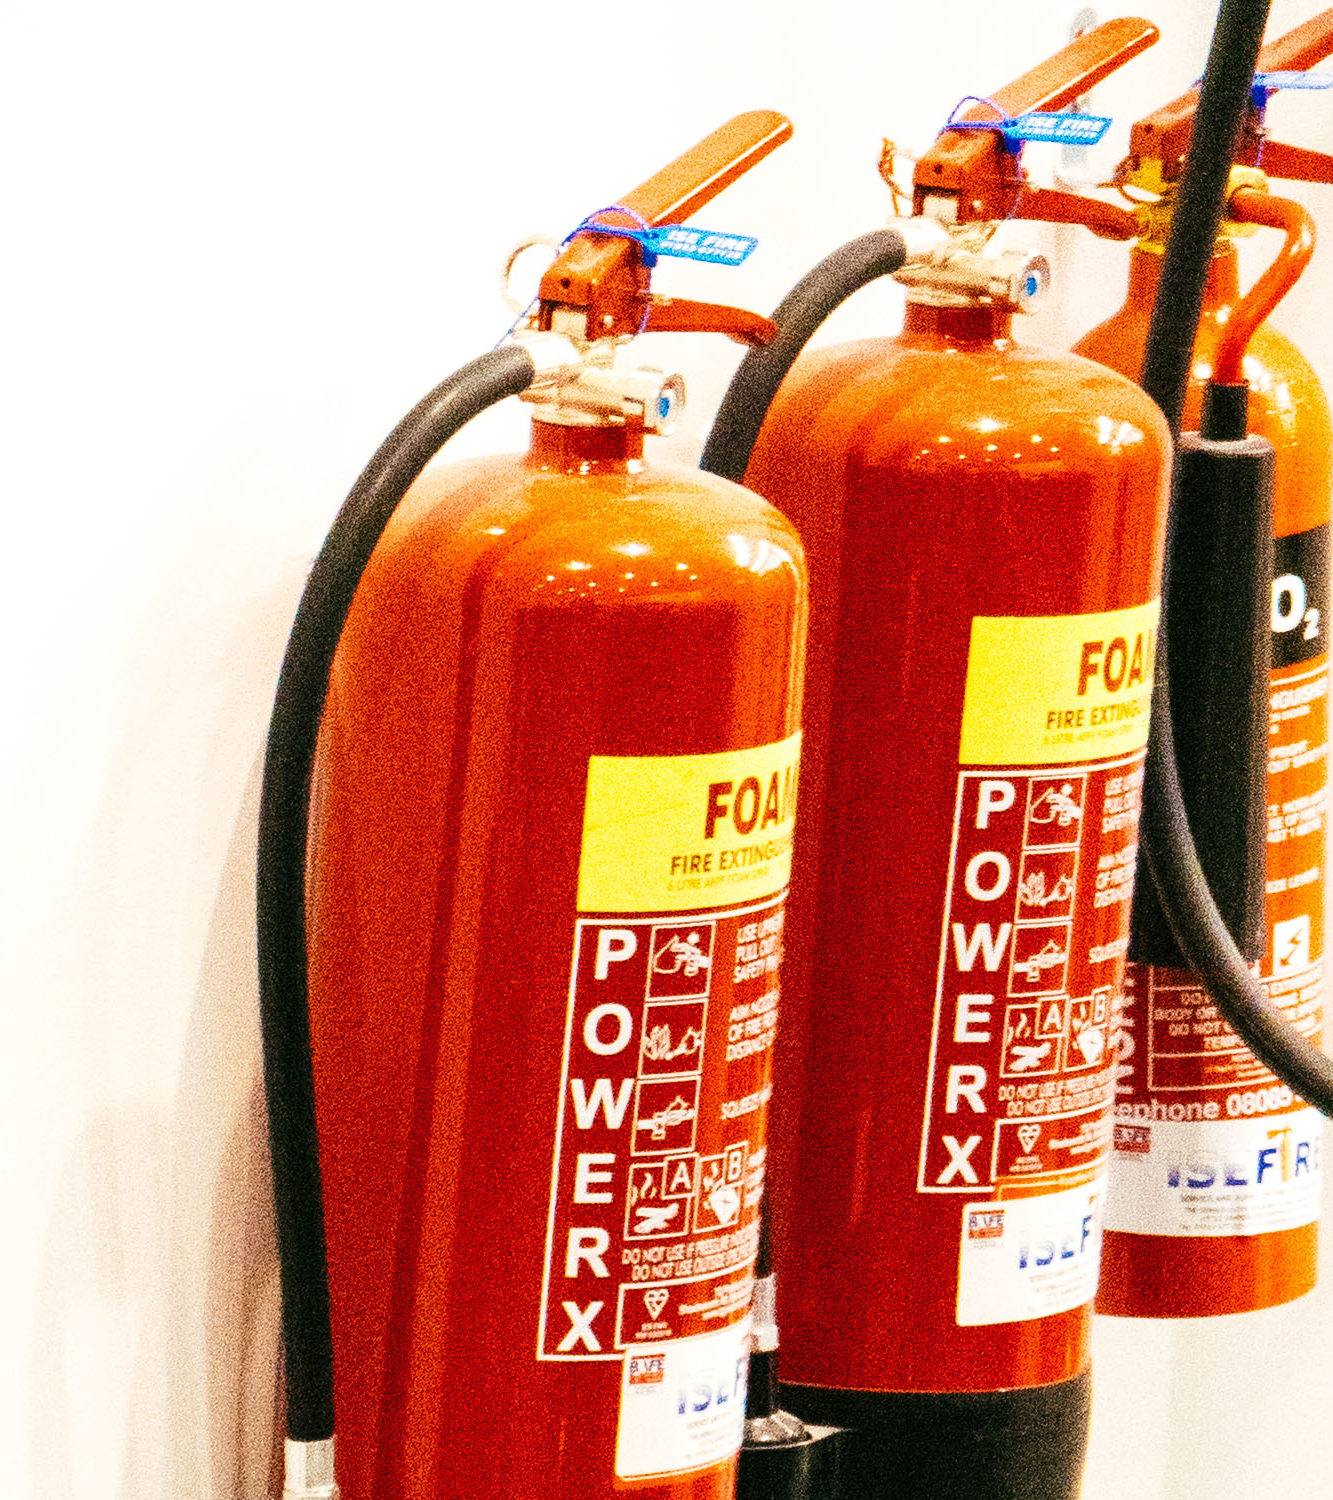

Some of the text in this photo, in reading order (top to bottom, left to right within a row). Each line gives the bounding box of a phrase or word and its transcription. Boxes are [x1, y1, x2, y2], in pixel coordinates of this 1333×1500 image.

[1270, 574, 1321, 641] O2
[1046, 708, 1085, 730] FIRE
[670, 853, 713, 875] FIRE
[1116, 1085, 1304, 1121] ephone 08085
[670, 1161, 691, 1192] A
